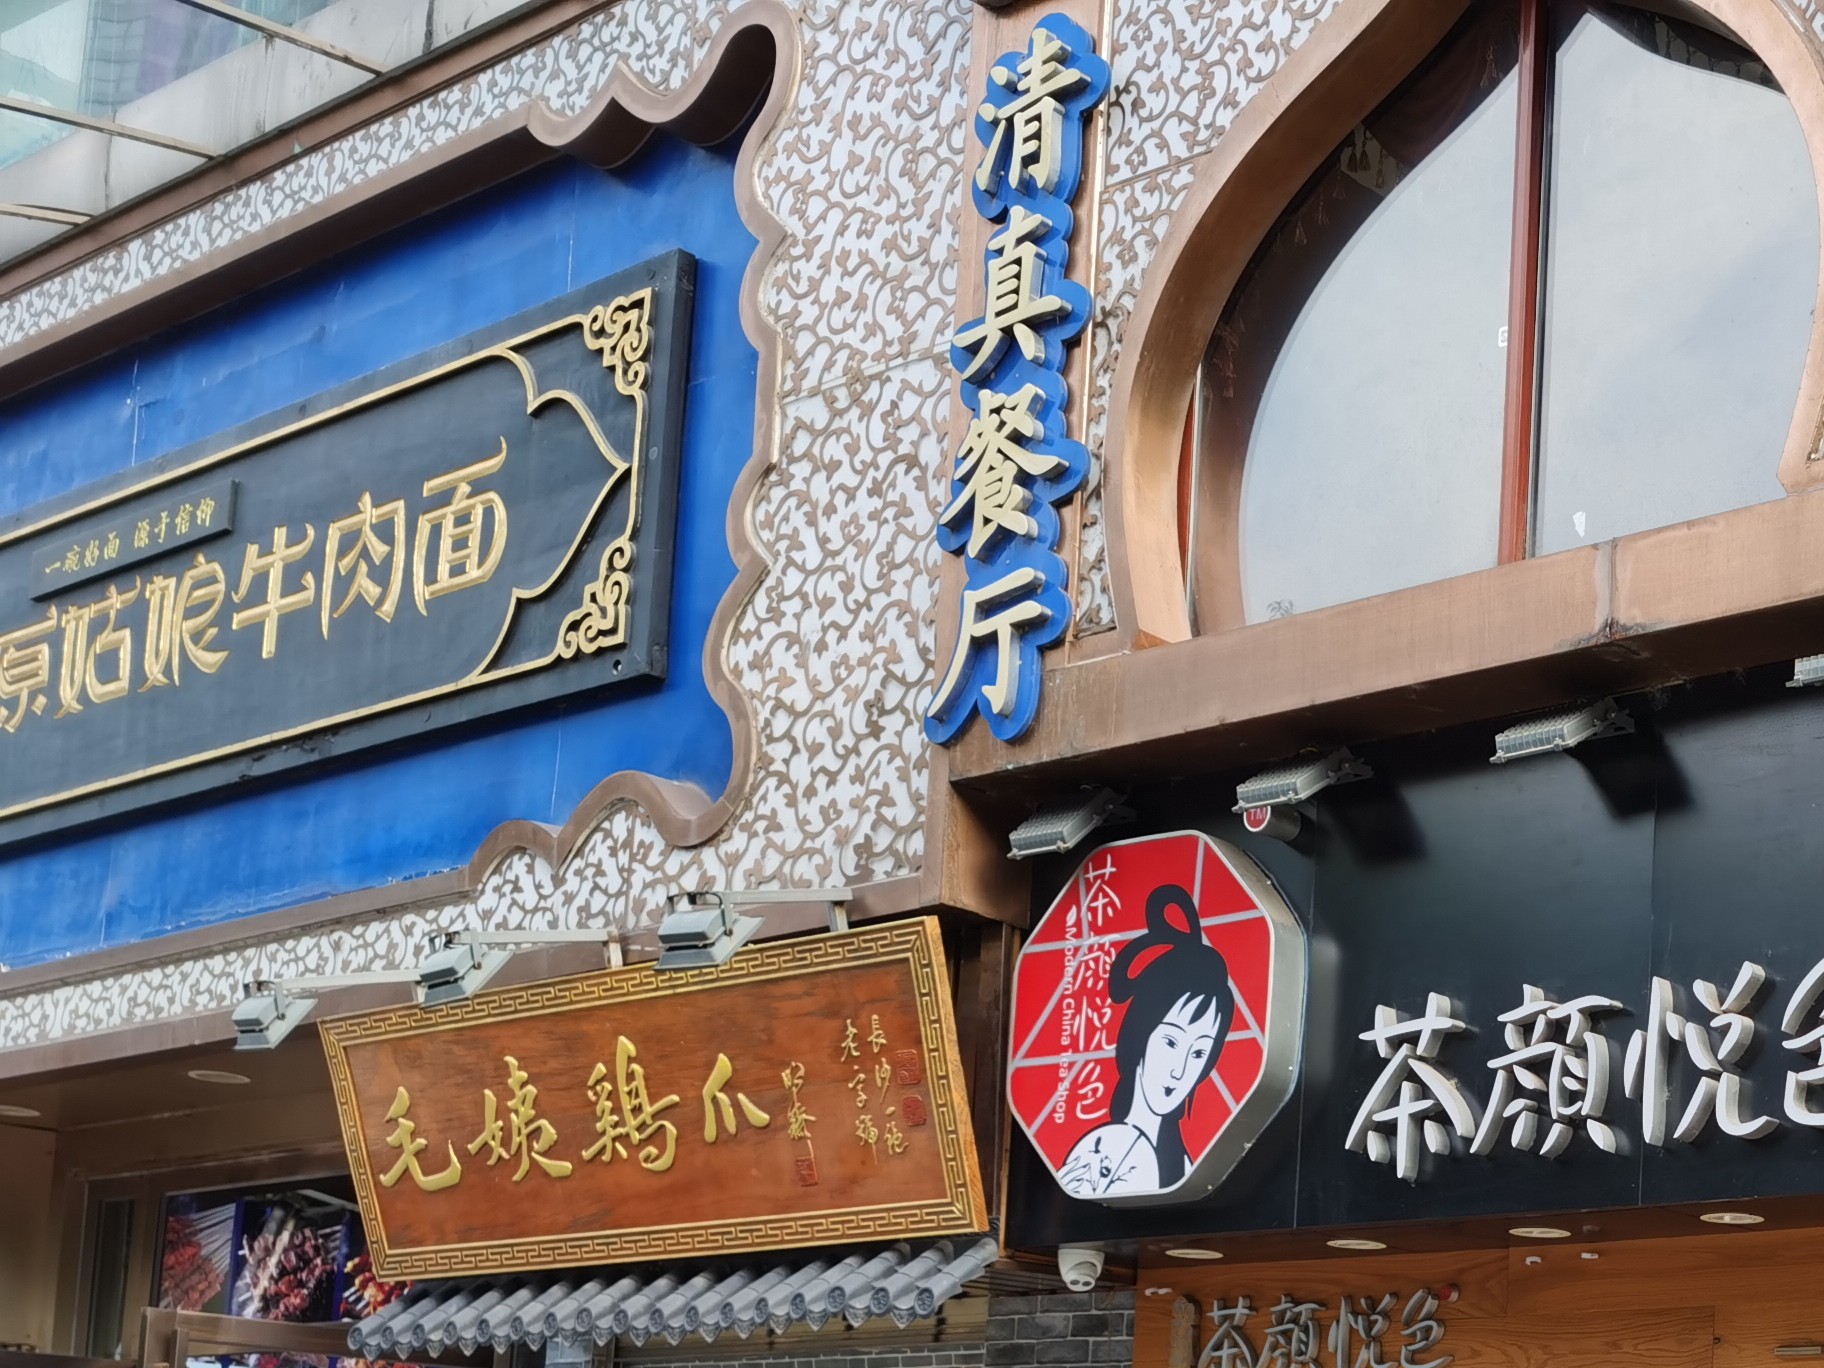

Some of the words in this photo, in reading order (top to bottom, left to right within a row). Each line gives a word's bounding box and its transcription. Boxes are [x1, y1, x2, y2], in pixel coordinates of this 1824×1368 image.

[928, 27, 1092, 720] 清真餐厅
[134, 497, 215, 548] 源于信仰
[1064, 927, 1075, 996] Modern
[1073, 853, 1121, 1121] 茶颜悦色
[1062, 998, 1074, 1046] China
[1060, 1049, 1073, 1078] Tea
[1054, 1080, 1070, 1124] Shop
